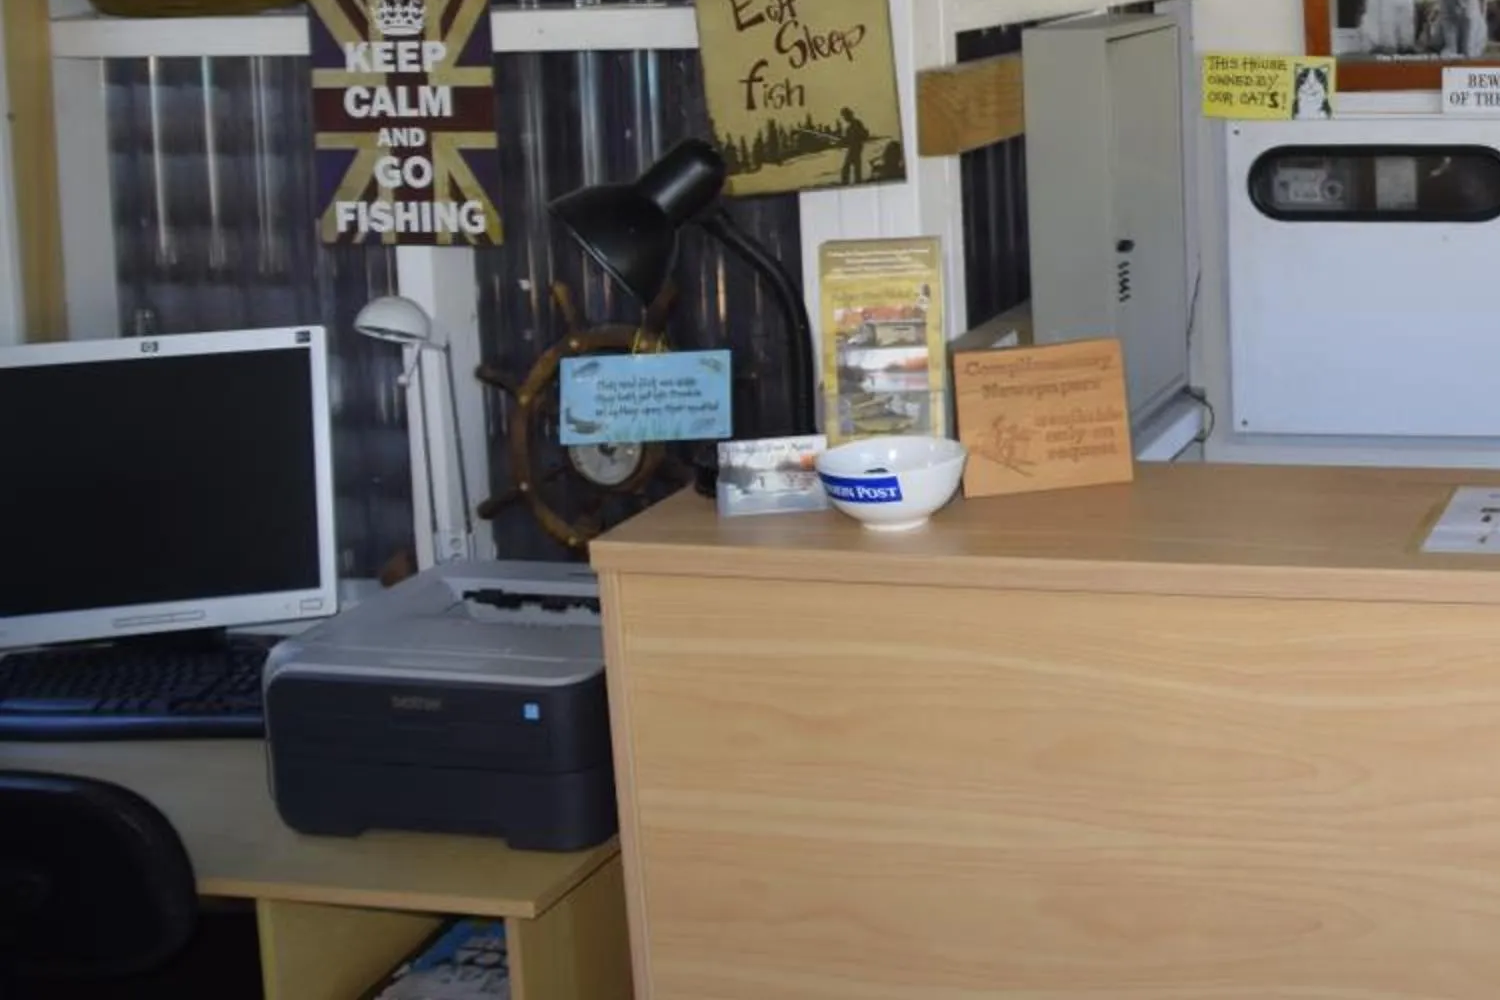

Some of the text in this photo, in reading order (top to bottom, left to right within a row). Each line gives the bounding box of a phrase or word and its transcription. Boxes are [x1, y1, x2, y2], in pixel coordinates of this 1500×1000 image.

[344, 41, 448, 73] KEEP
[774, 19, 867, 70] Sleep
[343, 85, 454, 117] CALM
[1449, 92, 1470, 106] OF
[377, 127, 427, 148] AND
[373, 155, 434, 189] GO
[335, 200, 488, 234] FISHING
[856, 485, 899, 500] POST
